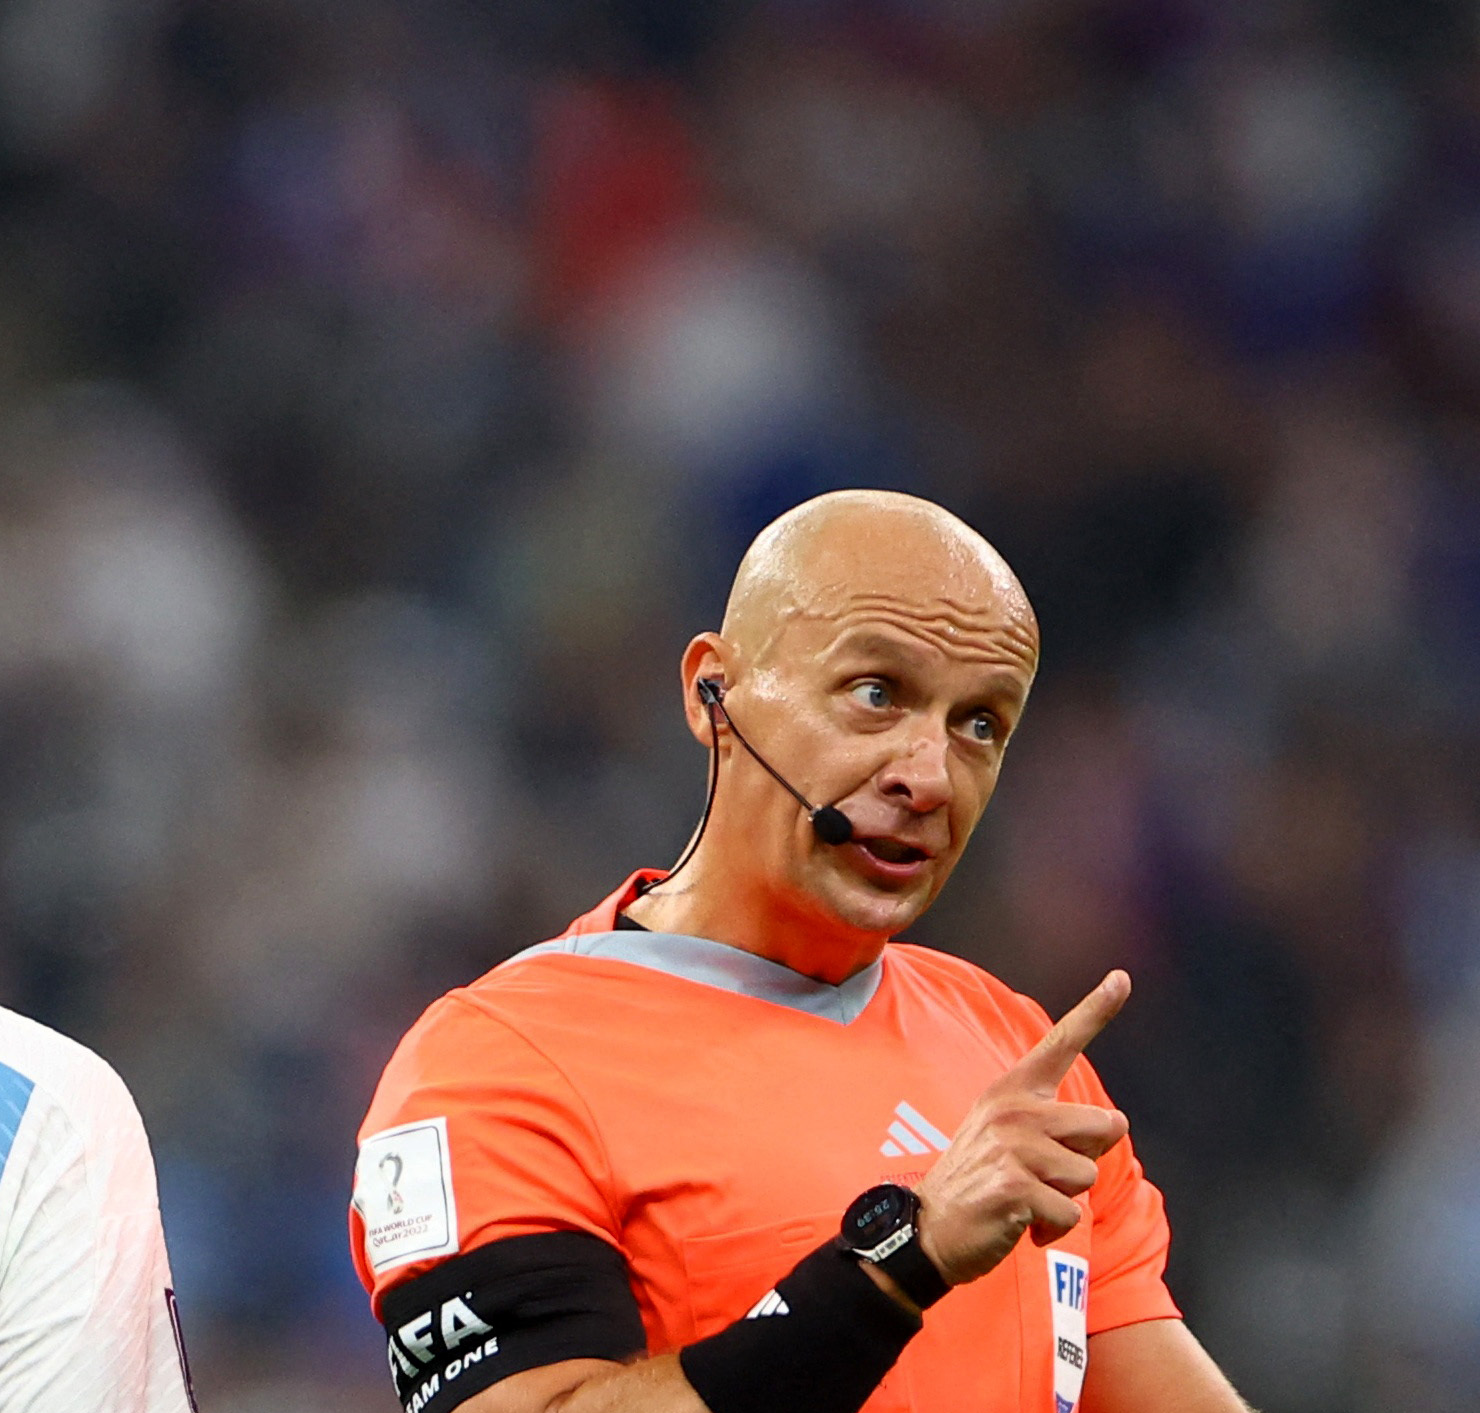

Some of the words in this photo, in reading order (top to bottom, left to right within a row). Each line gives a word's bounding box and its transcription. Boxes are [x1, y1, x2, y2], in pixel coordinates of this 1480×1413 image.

[383, 1217, 414, 1232] WORLD
[415, 1213, 433, 1224] CUP
[444, 1336, 499, 1381] ONE
